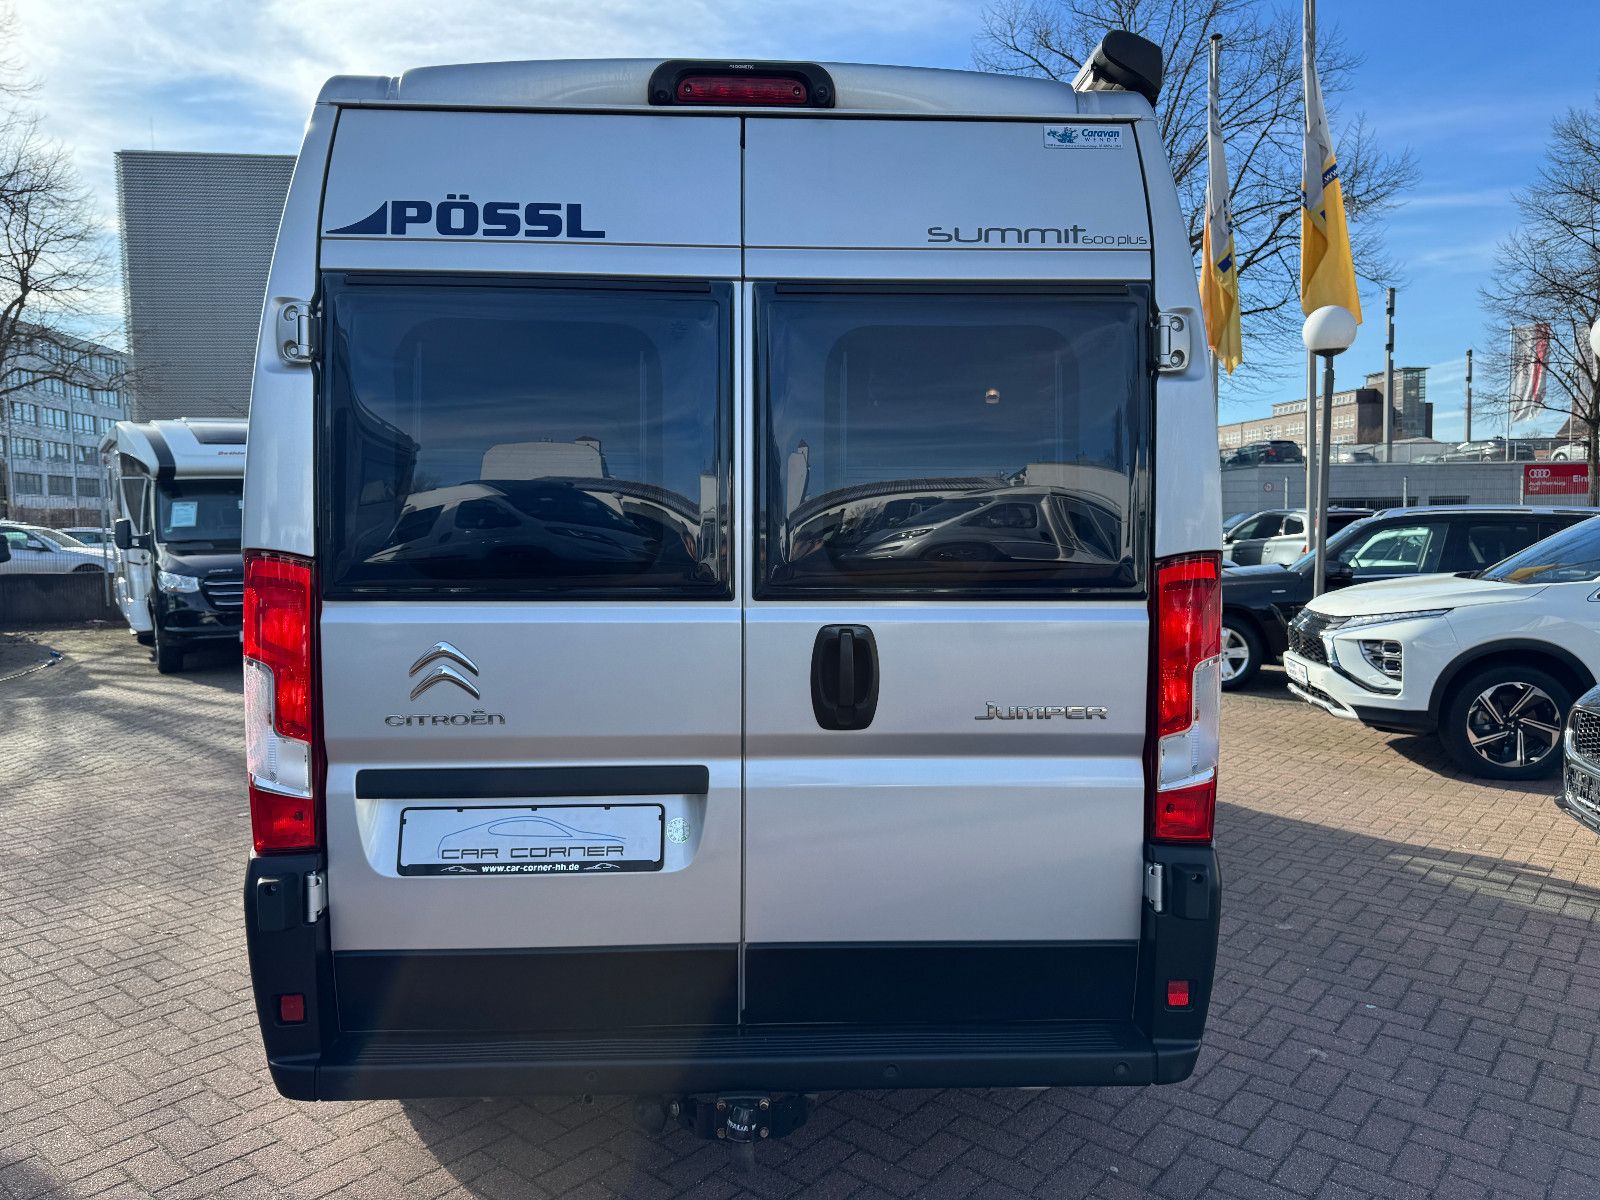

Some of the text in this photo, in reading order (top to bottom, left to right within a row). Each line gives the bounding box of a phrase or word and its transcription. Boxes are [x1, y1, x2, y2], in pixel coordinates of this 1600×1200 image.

[1081, 128, 1120, 138] Caravan
[390, 194, 605, 239] PÖSSL
[927, 224, 1147, 247] summit 600 plus
[441, 846, 624, 860] CAR CORNER
[481, 862, 580, 873] www.car-corner-hh.de
